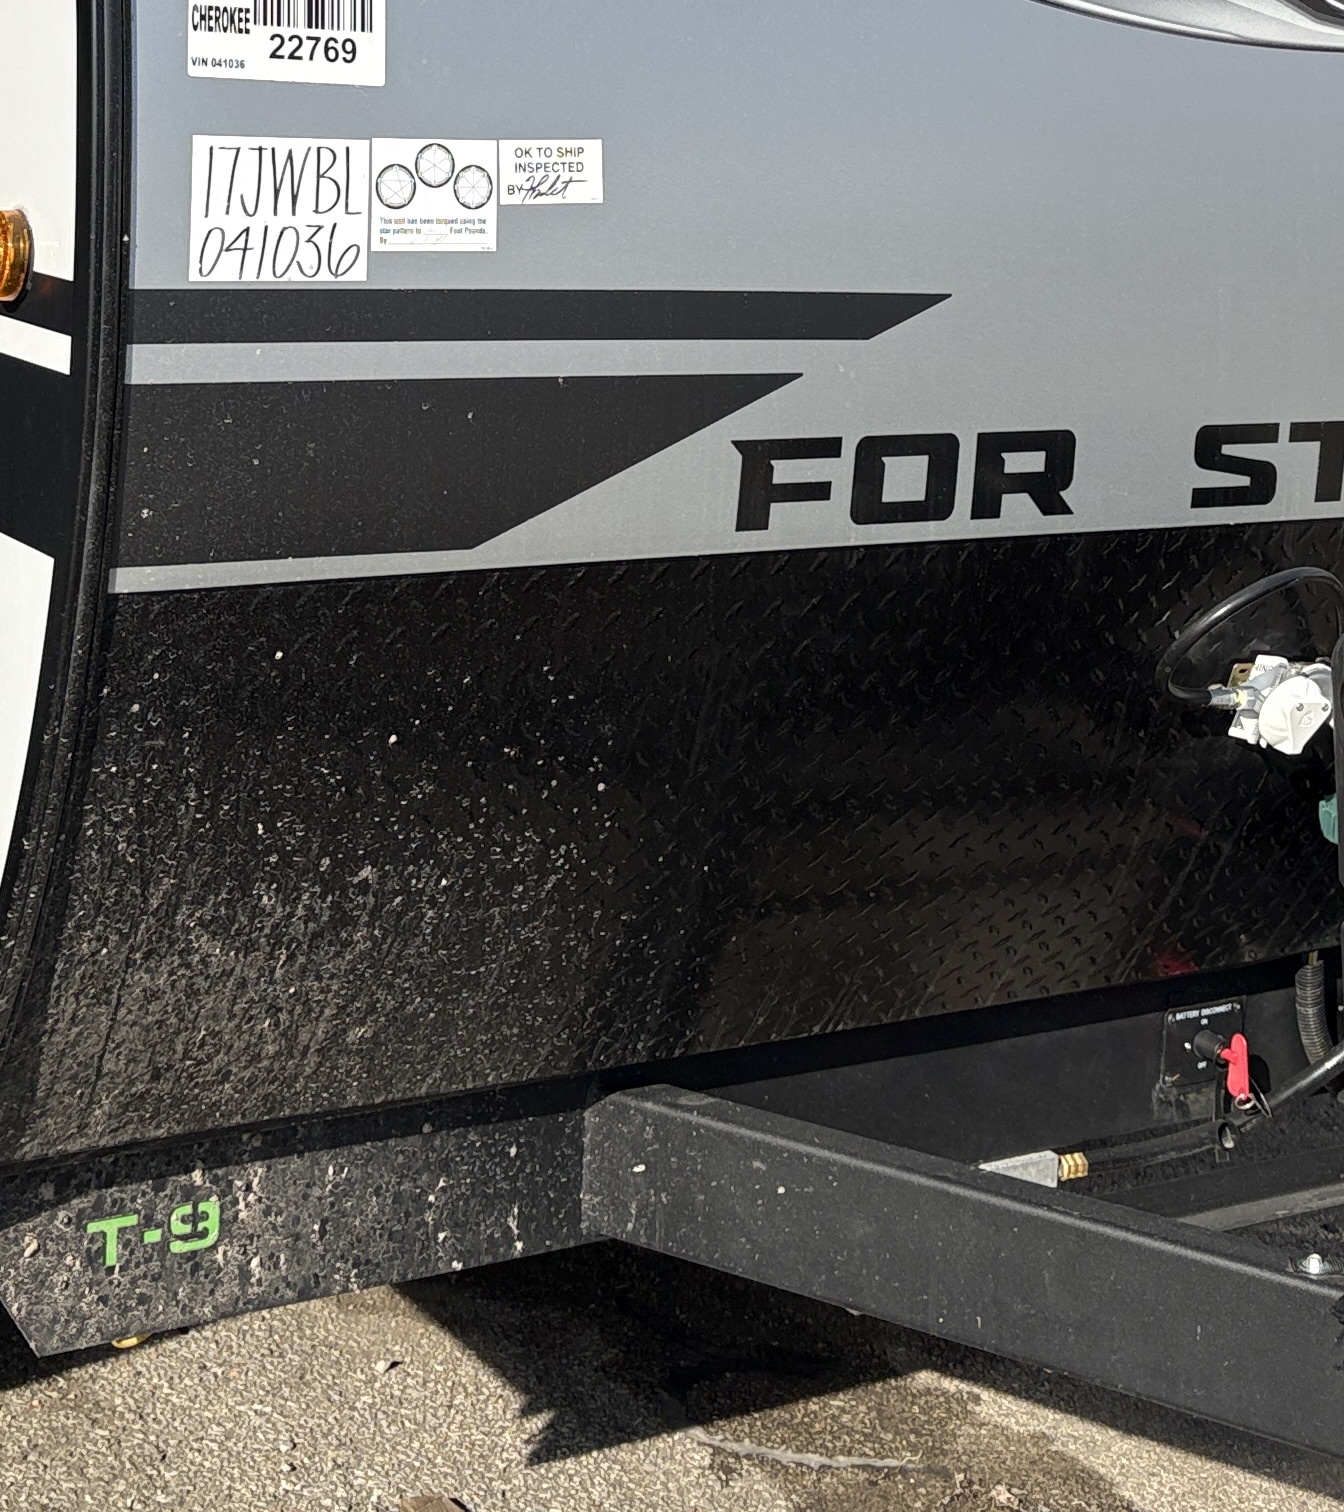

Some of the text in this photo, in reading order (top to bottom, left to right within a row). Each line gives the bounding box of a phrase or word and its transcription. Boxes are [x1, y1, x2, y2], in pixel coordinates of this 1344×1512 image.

[192, 4, 251, 34] CHEROKEE
[191, 57, 246, 69] VIN 041036
[269, 33, 357, 64] 22769
[514, 146, 584, 158] OK TO SHIP
[204, 145, 362, 218] 17JWBL
[515, 162, 584, 173] INSPECTED
[508, 184, 523, 195] BY
[199, 222, 360, 280] 041036
[730, 429, 1076, 532] FOR
[1176, 1002, 1232, 1021] BATTERY DISCONNECT
[86, 1200, 221, 1267] T-9
